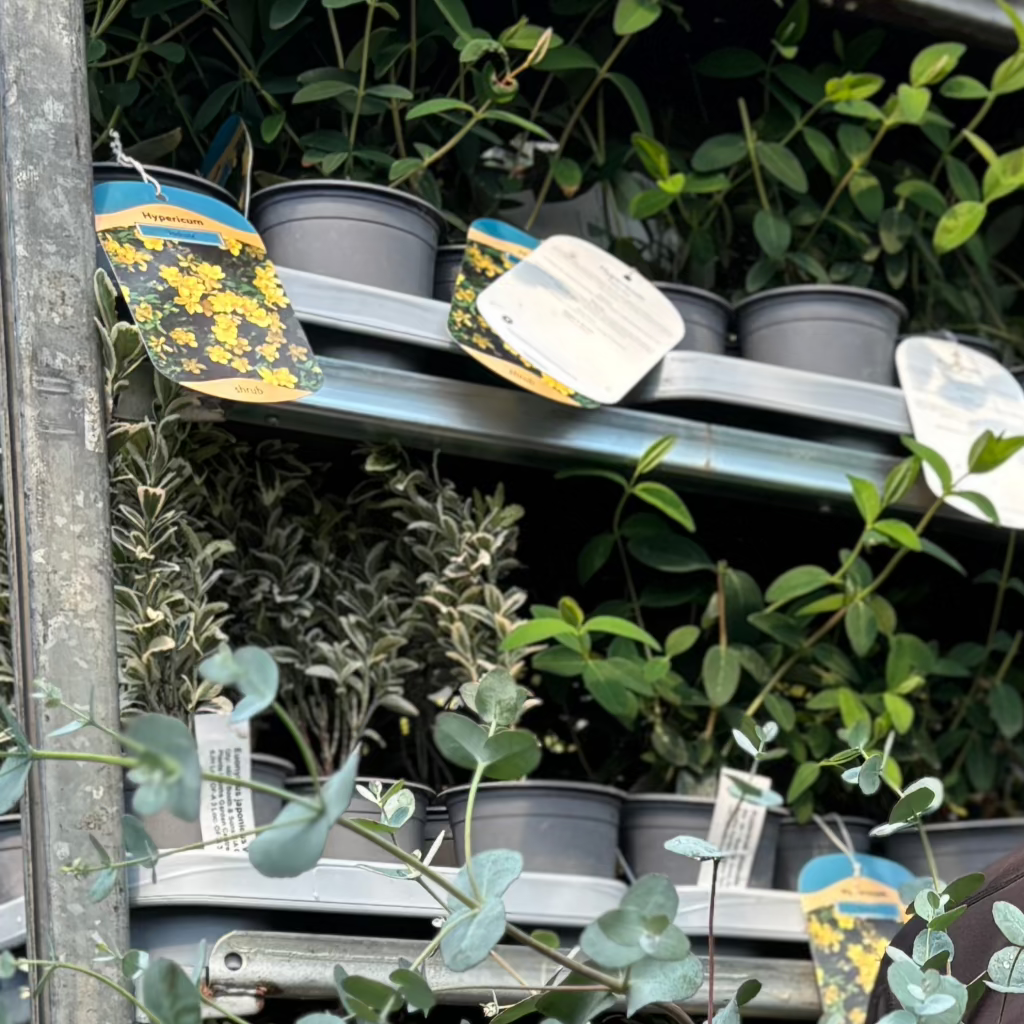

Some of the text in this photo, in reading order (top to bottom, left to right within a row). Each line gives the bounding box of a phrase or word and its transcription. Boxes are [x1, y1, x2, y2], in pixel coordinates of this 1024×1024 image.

[141, 211, 204, 226] Hypericum
[234, 386, 264, 395] shrub
[233, 747, 242, 797] Euonyus
